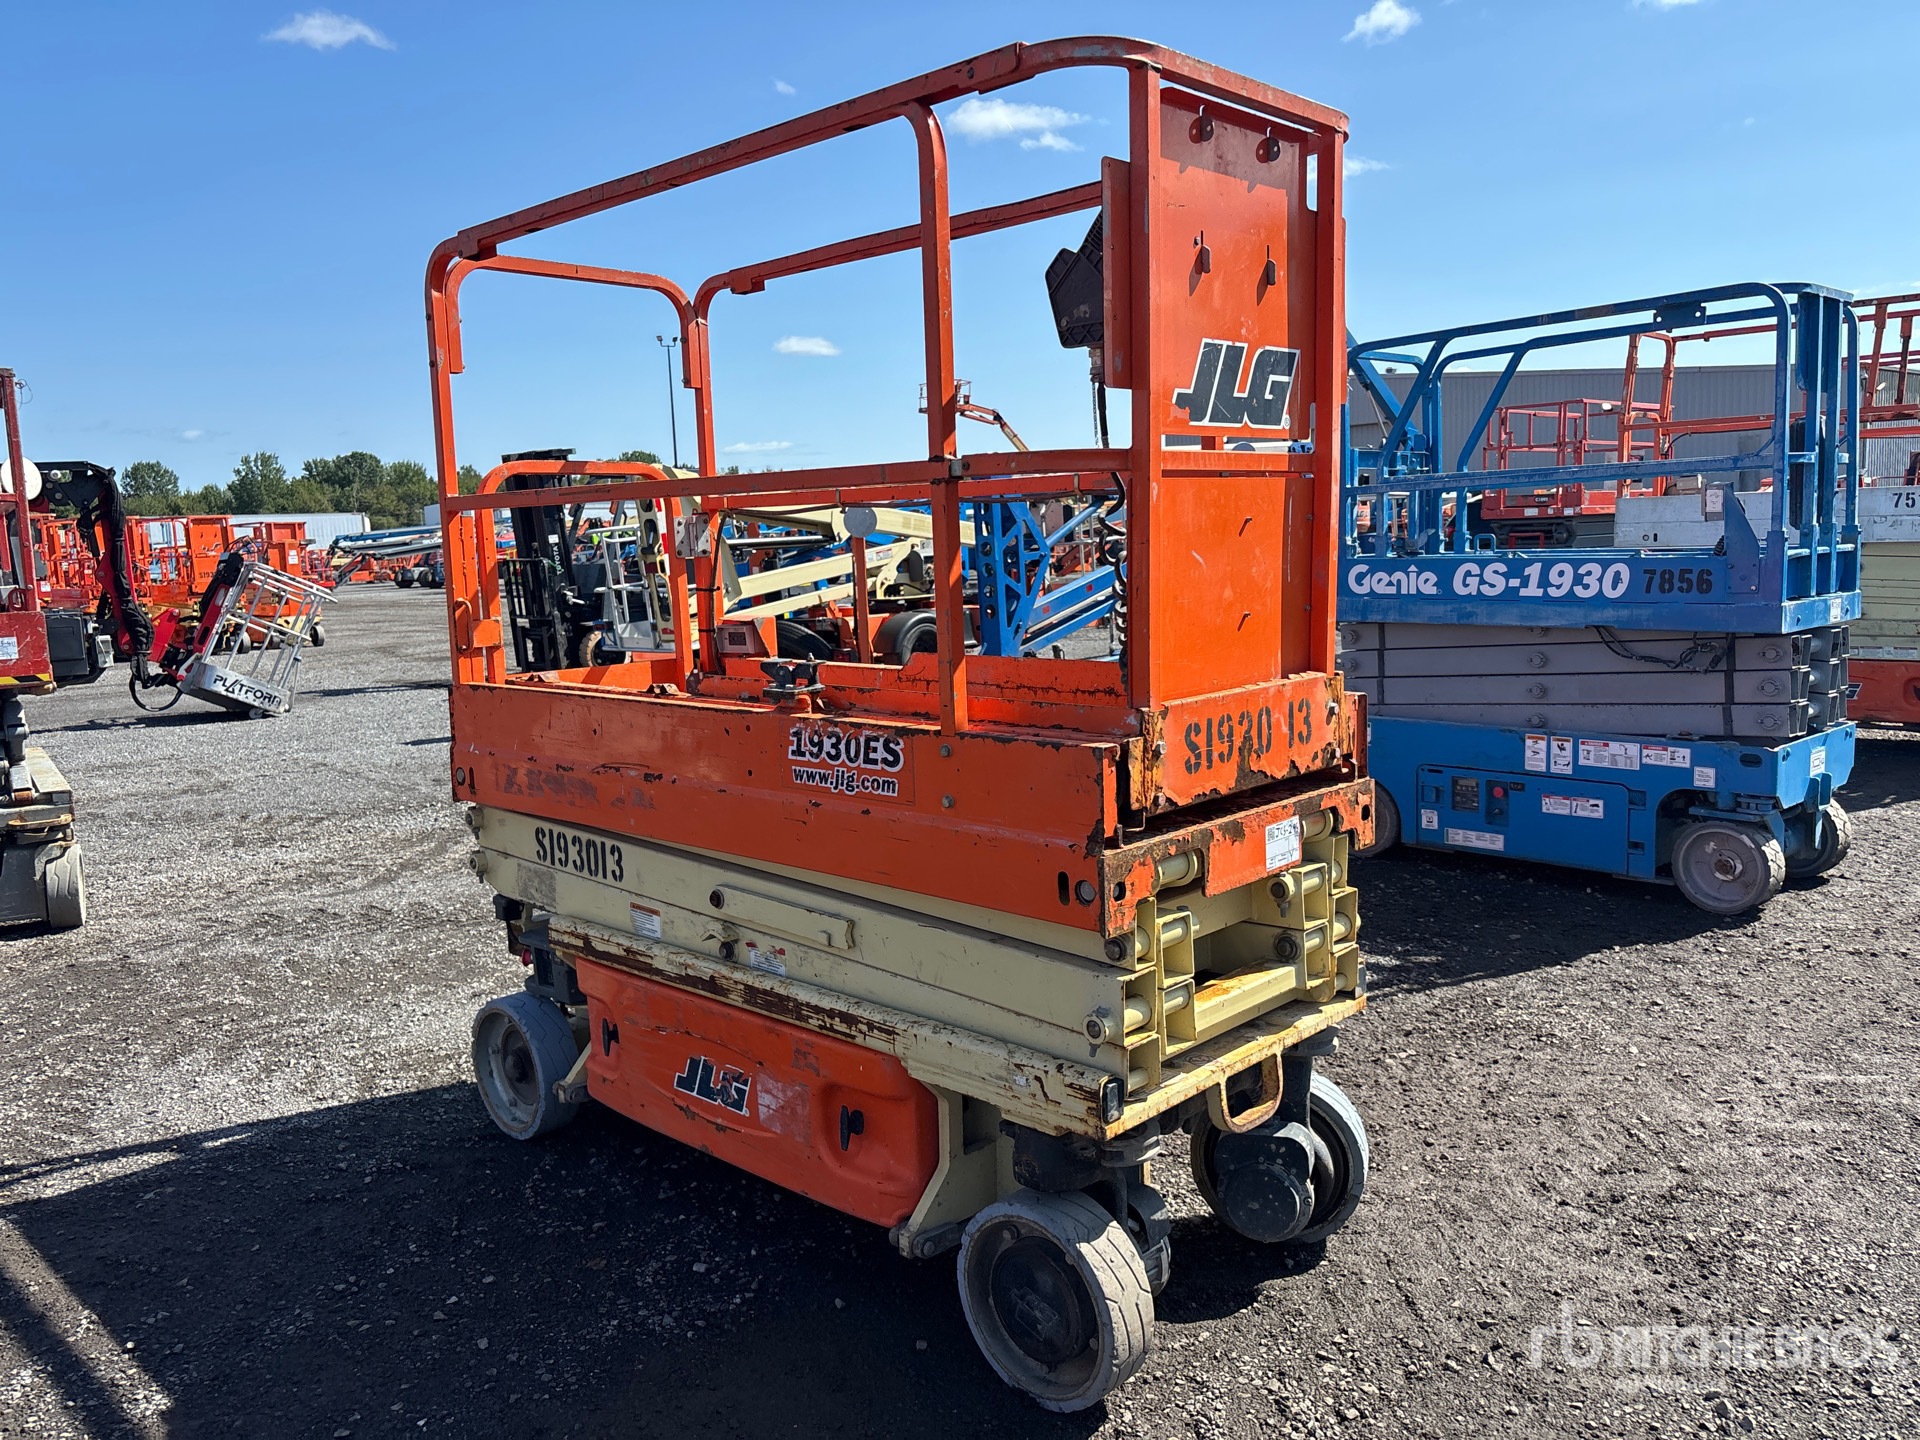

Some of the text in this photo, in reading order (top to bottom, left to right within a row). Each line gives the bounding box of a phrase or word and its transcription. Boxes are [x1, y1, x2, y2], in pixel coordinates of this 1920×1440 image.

[1171, 337, 1300, 430] JLG
[1892, 491, 1920, 509] 75
[552, 545, 565, 576] TOYOTA
[1347, 562, 1713, 598] Genie GS-1930 7856
[788, 725, 904, 772] 1930ES
[791, 766, 898, 796] www.jlg.com
[534, 826, 624, 883] S193013
[674, 1055, 751, 1116] JLG
